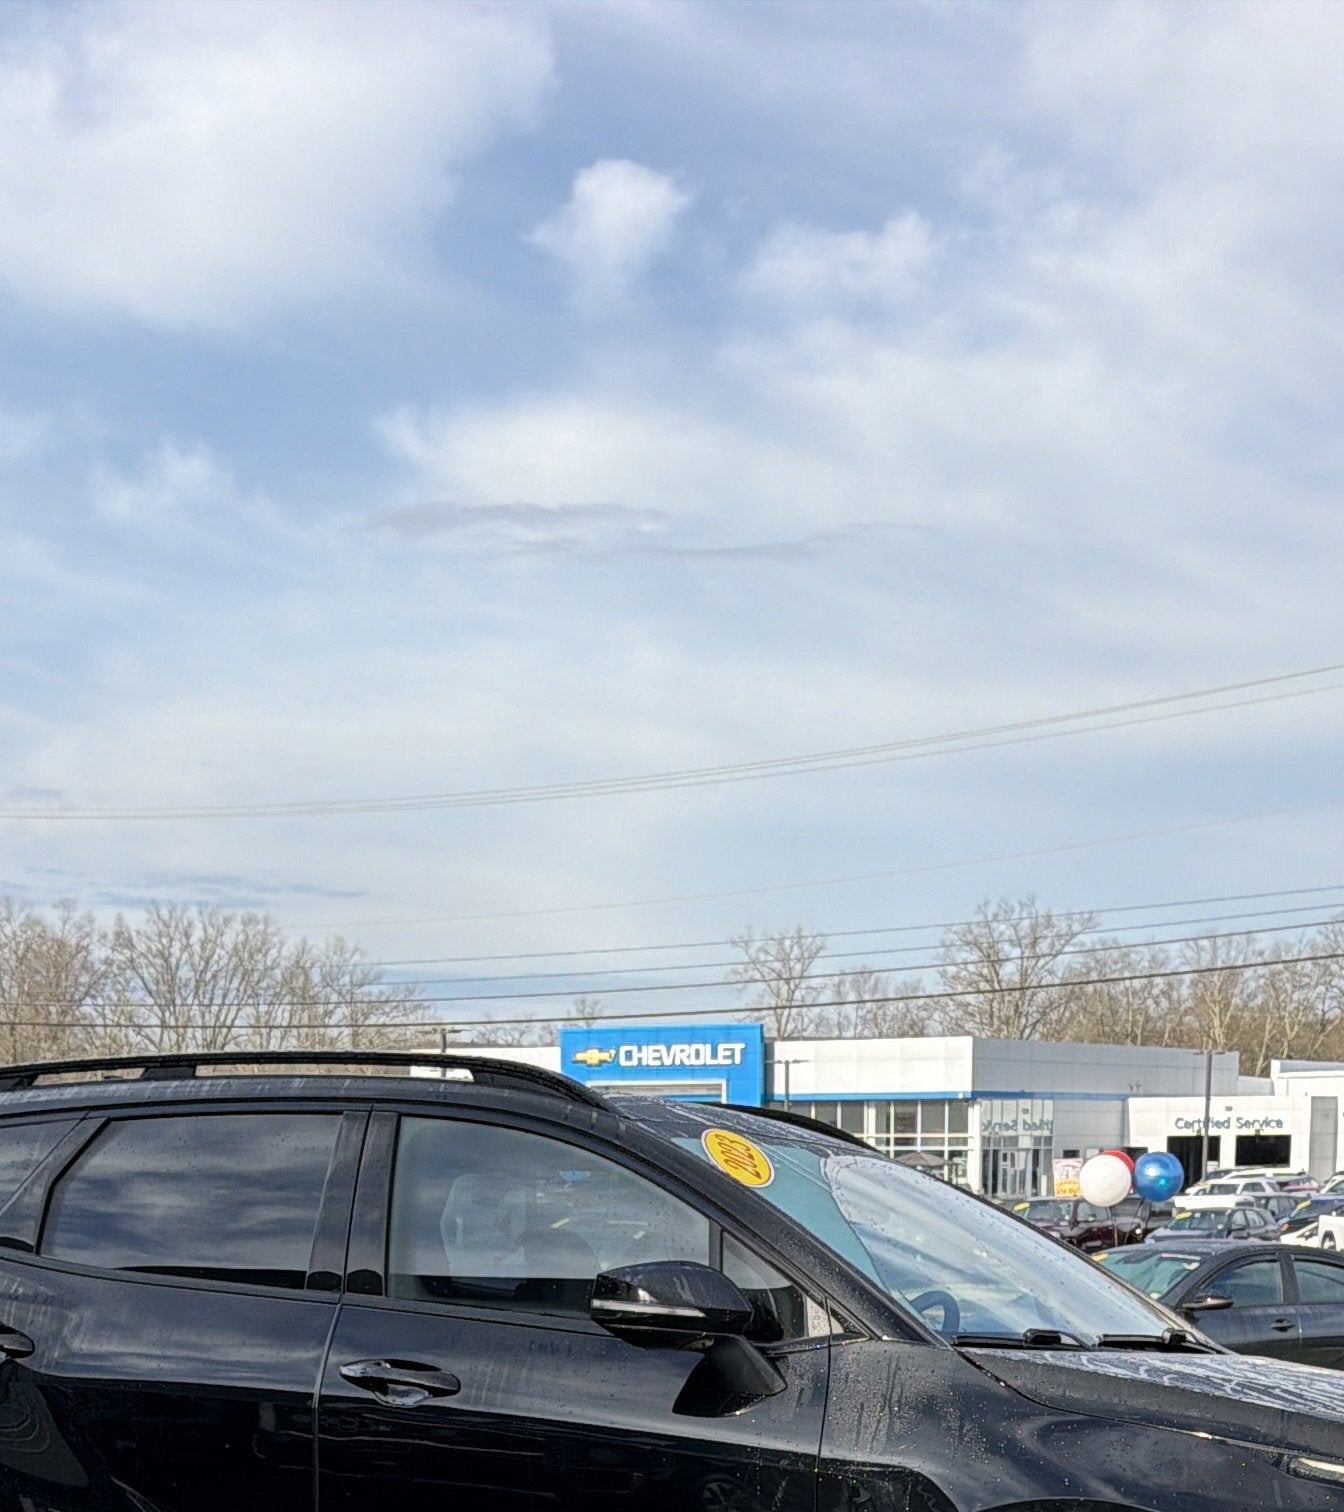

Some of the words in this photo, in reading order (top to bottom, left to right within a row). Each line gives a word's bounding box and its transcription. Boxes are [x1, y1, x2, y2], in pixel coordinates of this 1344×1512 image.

[619, 1043, 746, 1067] CHEVROLET
[1235, 1116, 1284, 1131] Service
[713, 1132, 763, 1180] 2023
